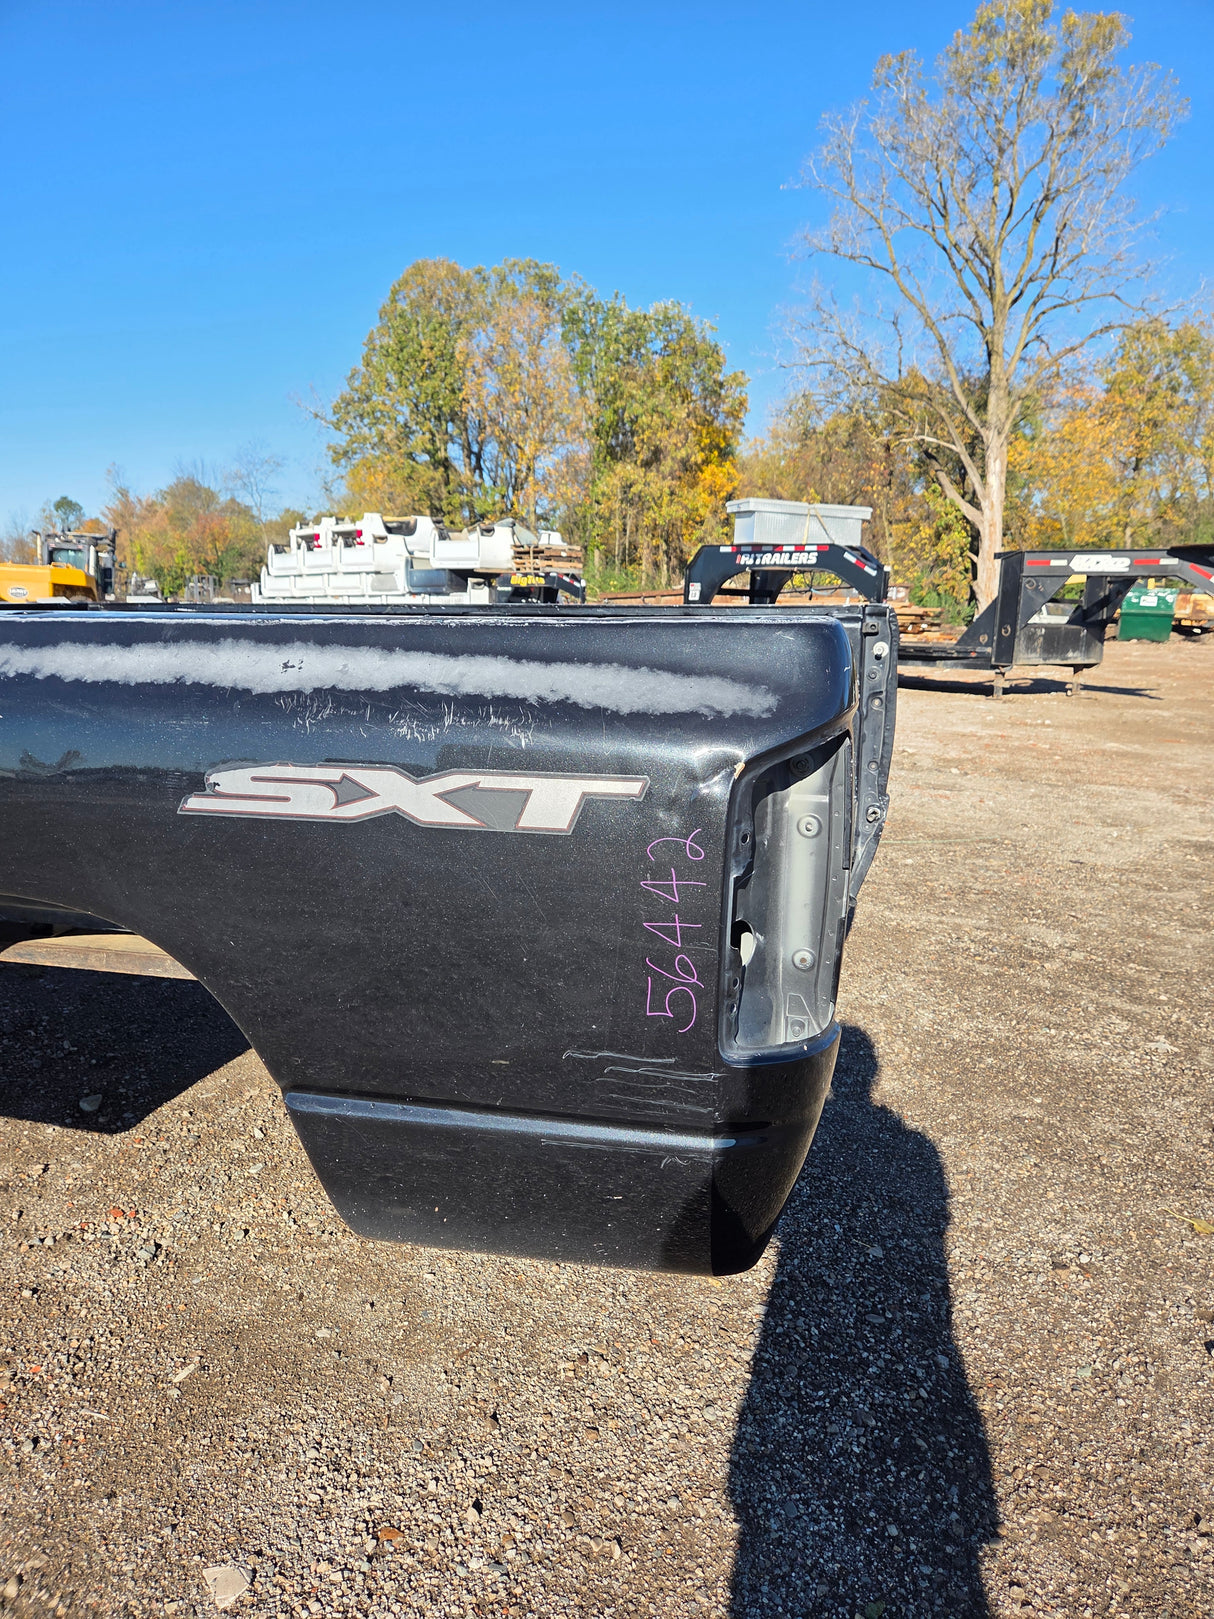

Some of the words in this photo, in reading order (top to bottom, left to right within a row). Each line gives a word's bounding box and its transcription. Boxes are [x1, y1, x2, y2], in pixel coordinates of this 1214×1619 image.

[755, 551, 818, 565] TRAILERS
[178, 762, 649, 835] SXT
[640, 828, 707, 1033] 56442
